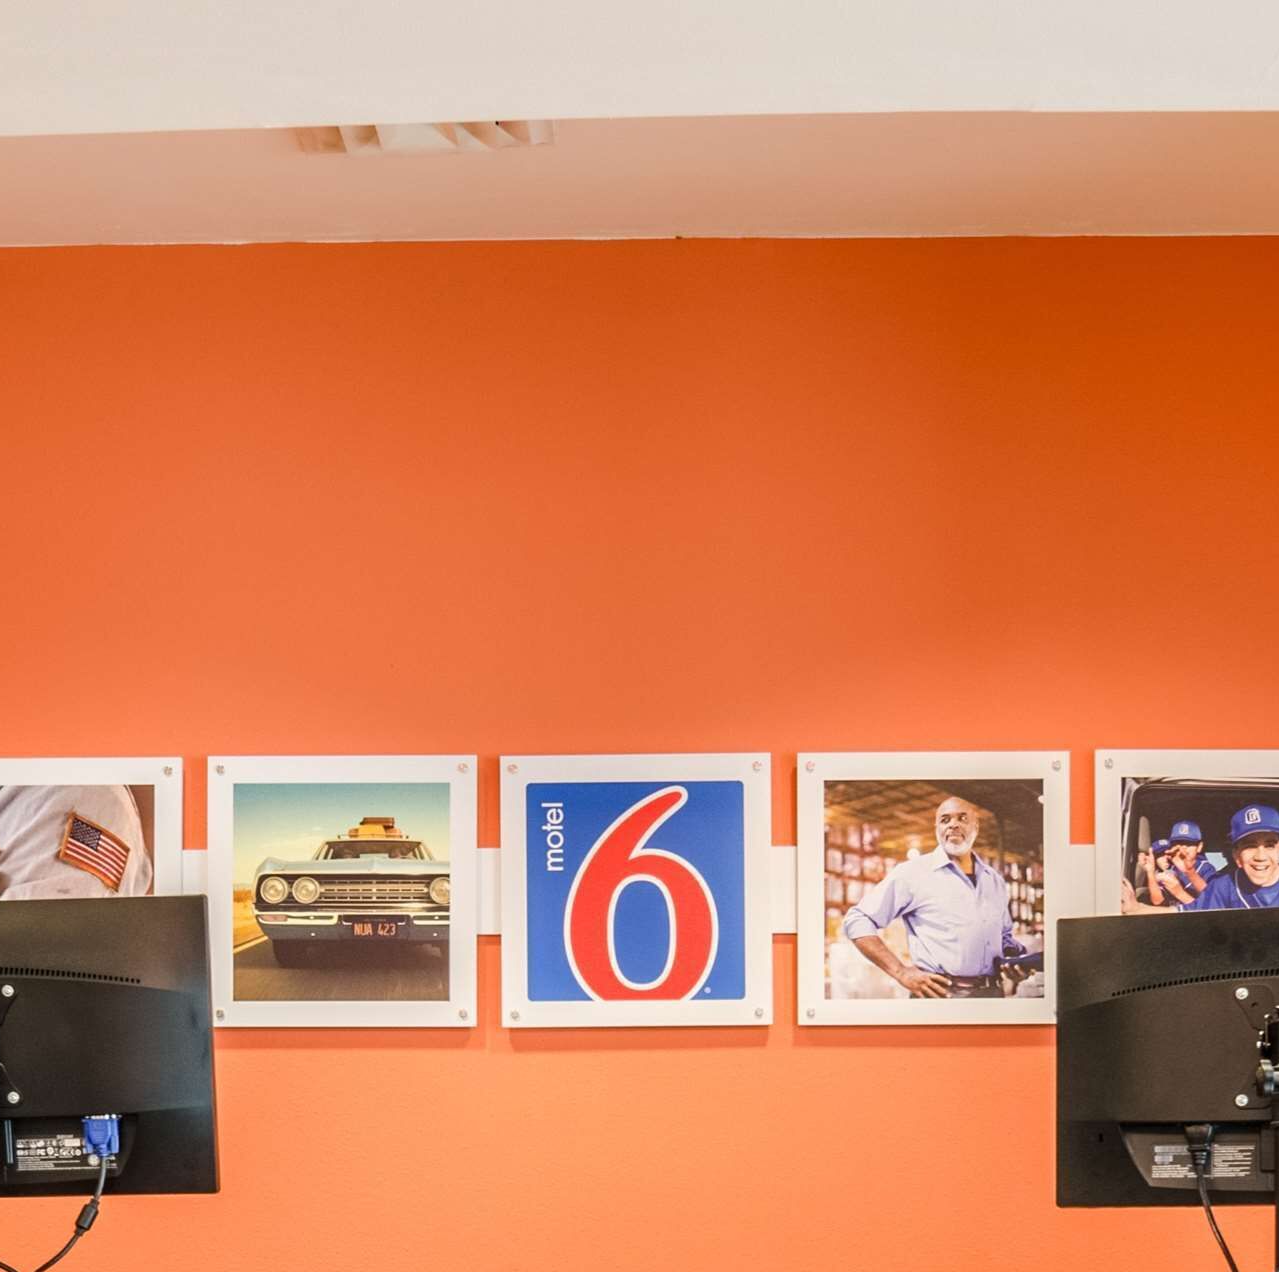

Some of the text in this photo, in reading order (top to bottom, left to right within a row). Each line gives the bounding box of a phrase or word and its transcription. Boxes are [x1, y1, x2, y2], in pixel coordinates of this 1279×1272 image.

[541, 802, 564, 872] motel
[563, 785, 719, 1001] 6
[377, 922, 397, 936] 423
